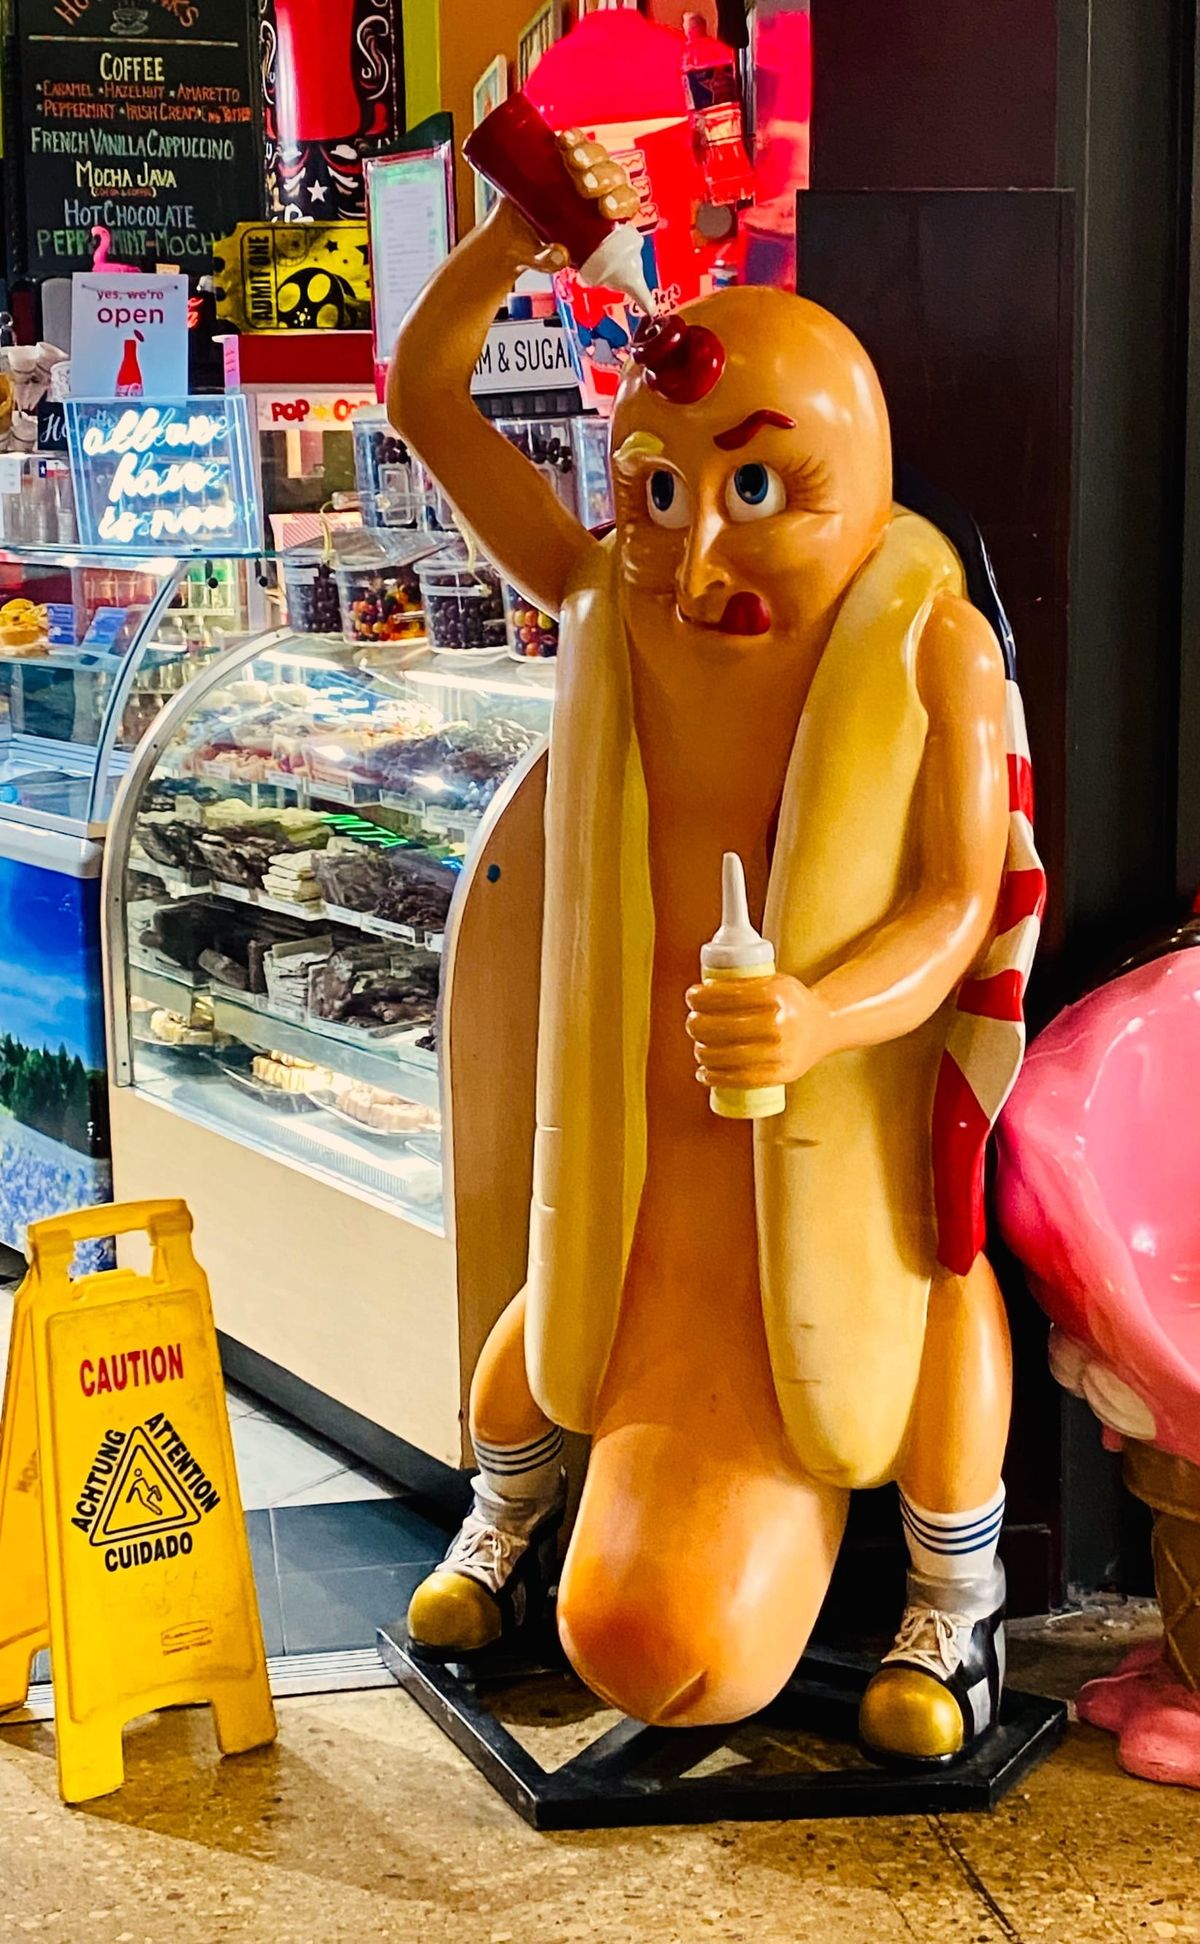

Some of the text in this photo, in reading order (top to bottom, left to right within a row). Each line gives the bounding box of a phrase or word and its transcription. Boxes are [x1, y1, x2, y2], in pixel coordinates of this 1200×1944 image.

[100, 52, 165, 81] COFFEE
[43, 80, 240, 102] CARAMEL HAZELNUT AMARETTO
[44, 99, 116, 119] PEPPERMINT
[126, 102, 157, 121] IRISH
[31, 127, 234, 160] FRENCH VANILLA CAPPUCCINO
[76, 160, 177, 188] MOCHA JAVA
[64, 198, 196, 229] HOT CHOCOLATE
[248, 236, 273, 320] ADMIT ONE
[97, 288, 164, 301] yes, we're
[97, 307, 164, 328] open
[498, 342, 510, 373] &
[271, 399, 310, 422] POP
[83, 408, 160, 456] all
[108, 452, 220, 502] have
[98, 504, 236, 543] is now
[80, 1343, 184, 1397] CAUTION
[144, 1412, 221, 1514] ATTENTION
[71, 1429, 126, 1533] ACHTUNG
[104, 1531, 193, 1572] CUIDADO
